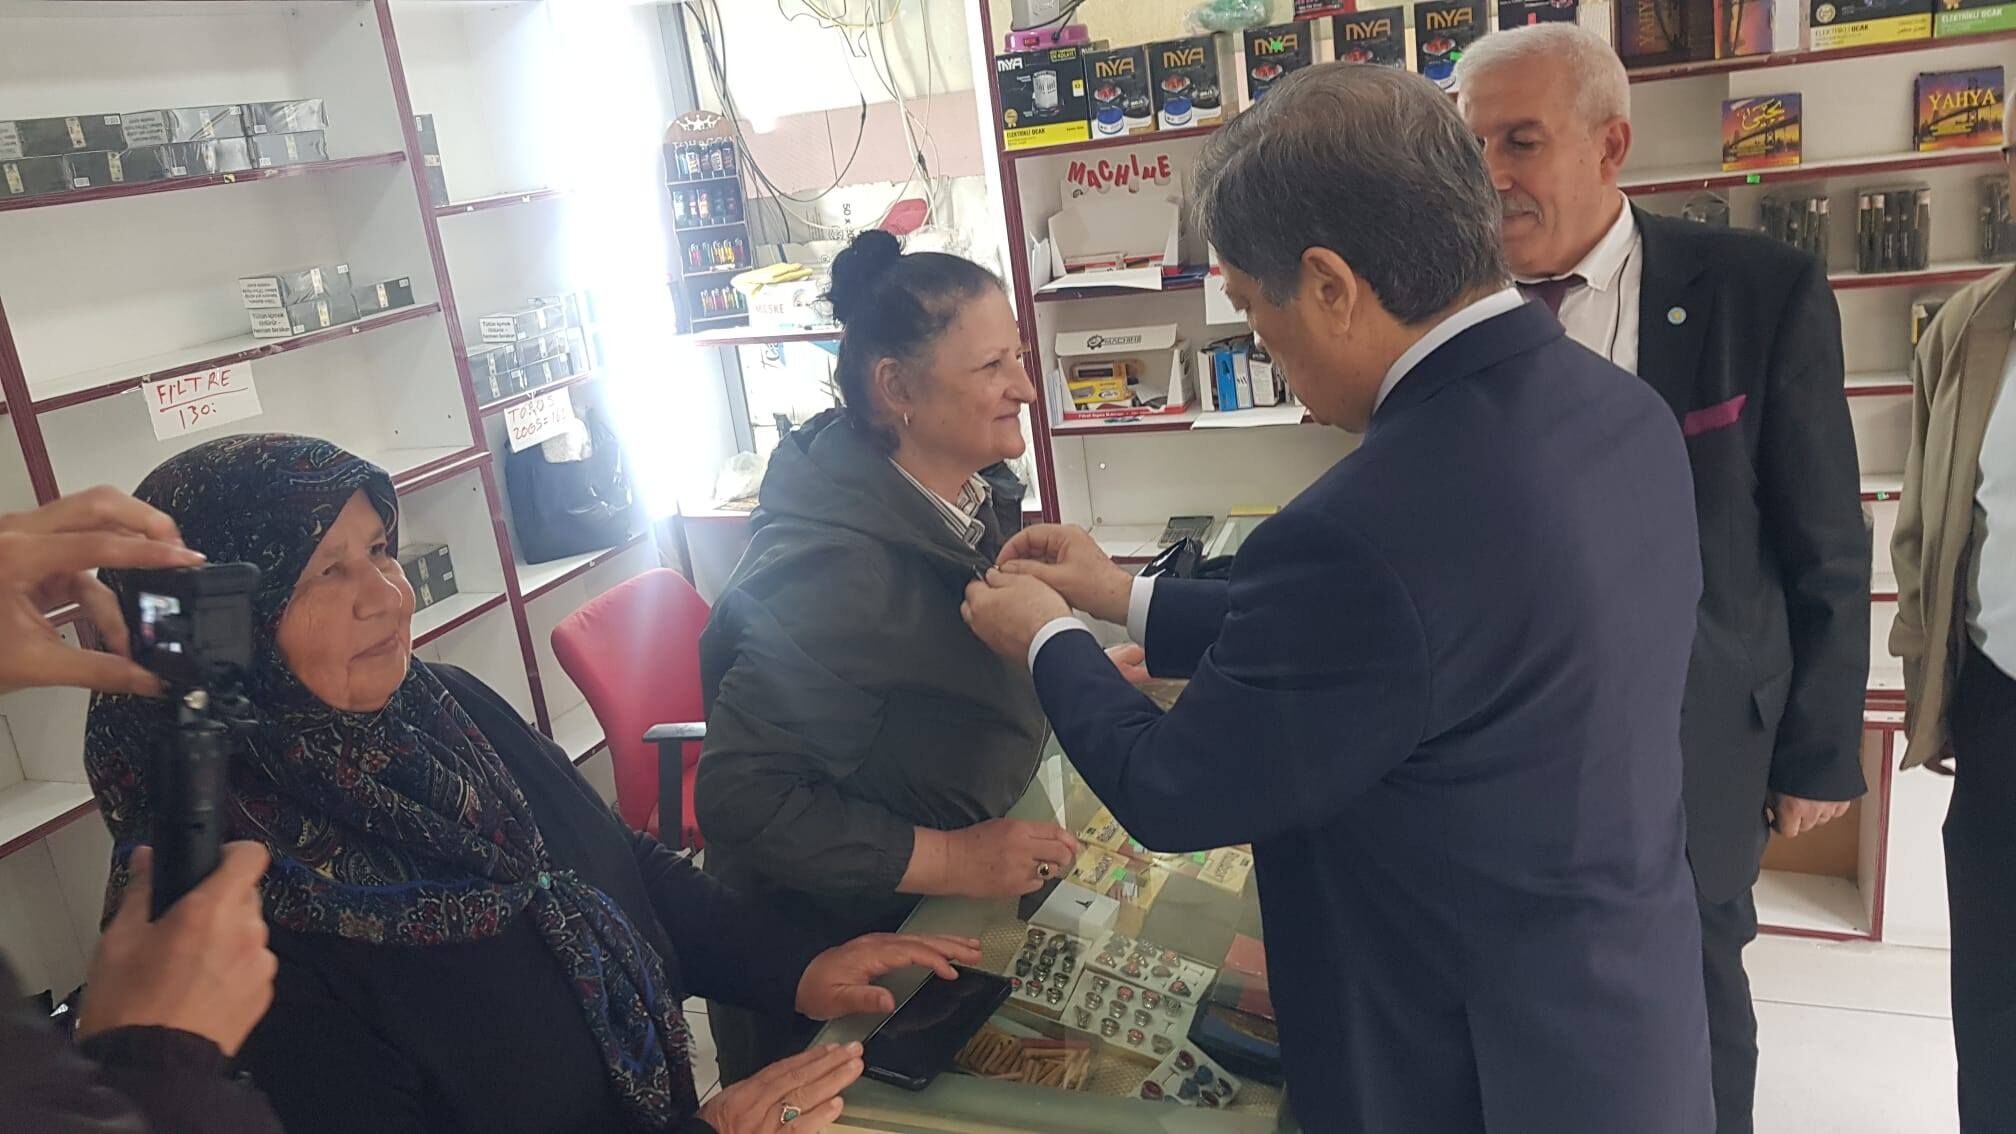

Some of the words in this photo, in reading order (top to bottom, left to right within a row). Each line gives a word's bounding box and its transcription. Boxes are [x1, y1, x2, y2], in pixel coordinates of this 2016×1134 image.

[1345, 18, 1391, 41] MYA
[1426, 7, 1474, 31] MYA
[997, 57, 1023, 73] MYA
[1095, 57, 1135, 78] MYA
[1163, 47, 1205, 69] MYA
[1928, 87, 1997, 112] YAHYA
[1067, 153, 1172, 189] MACHINE
